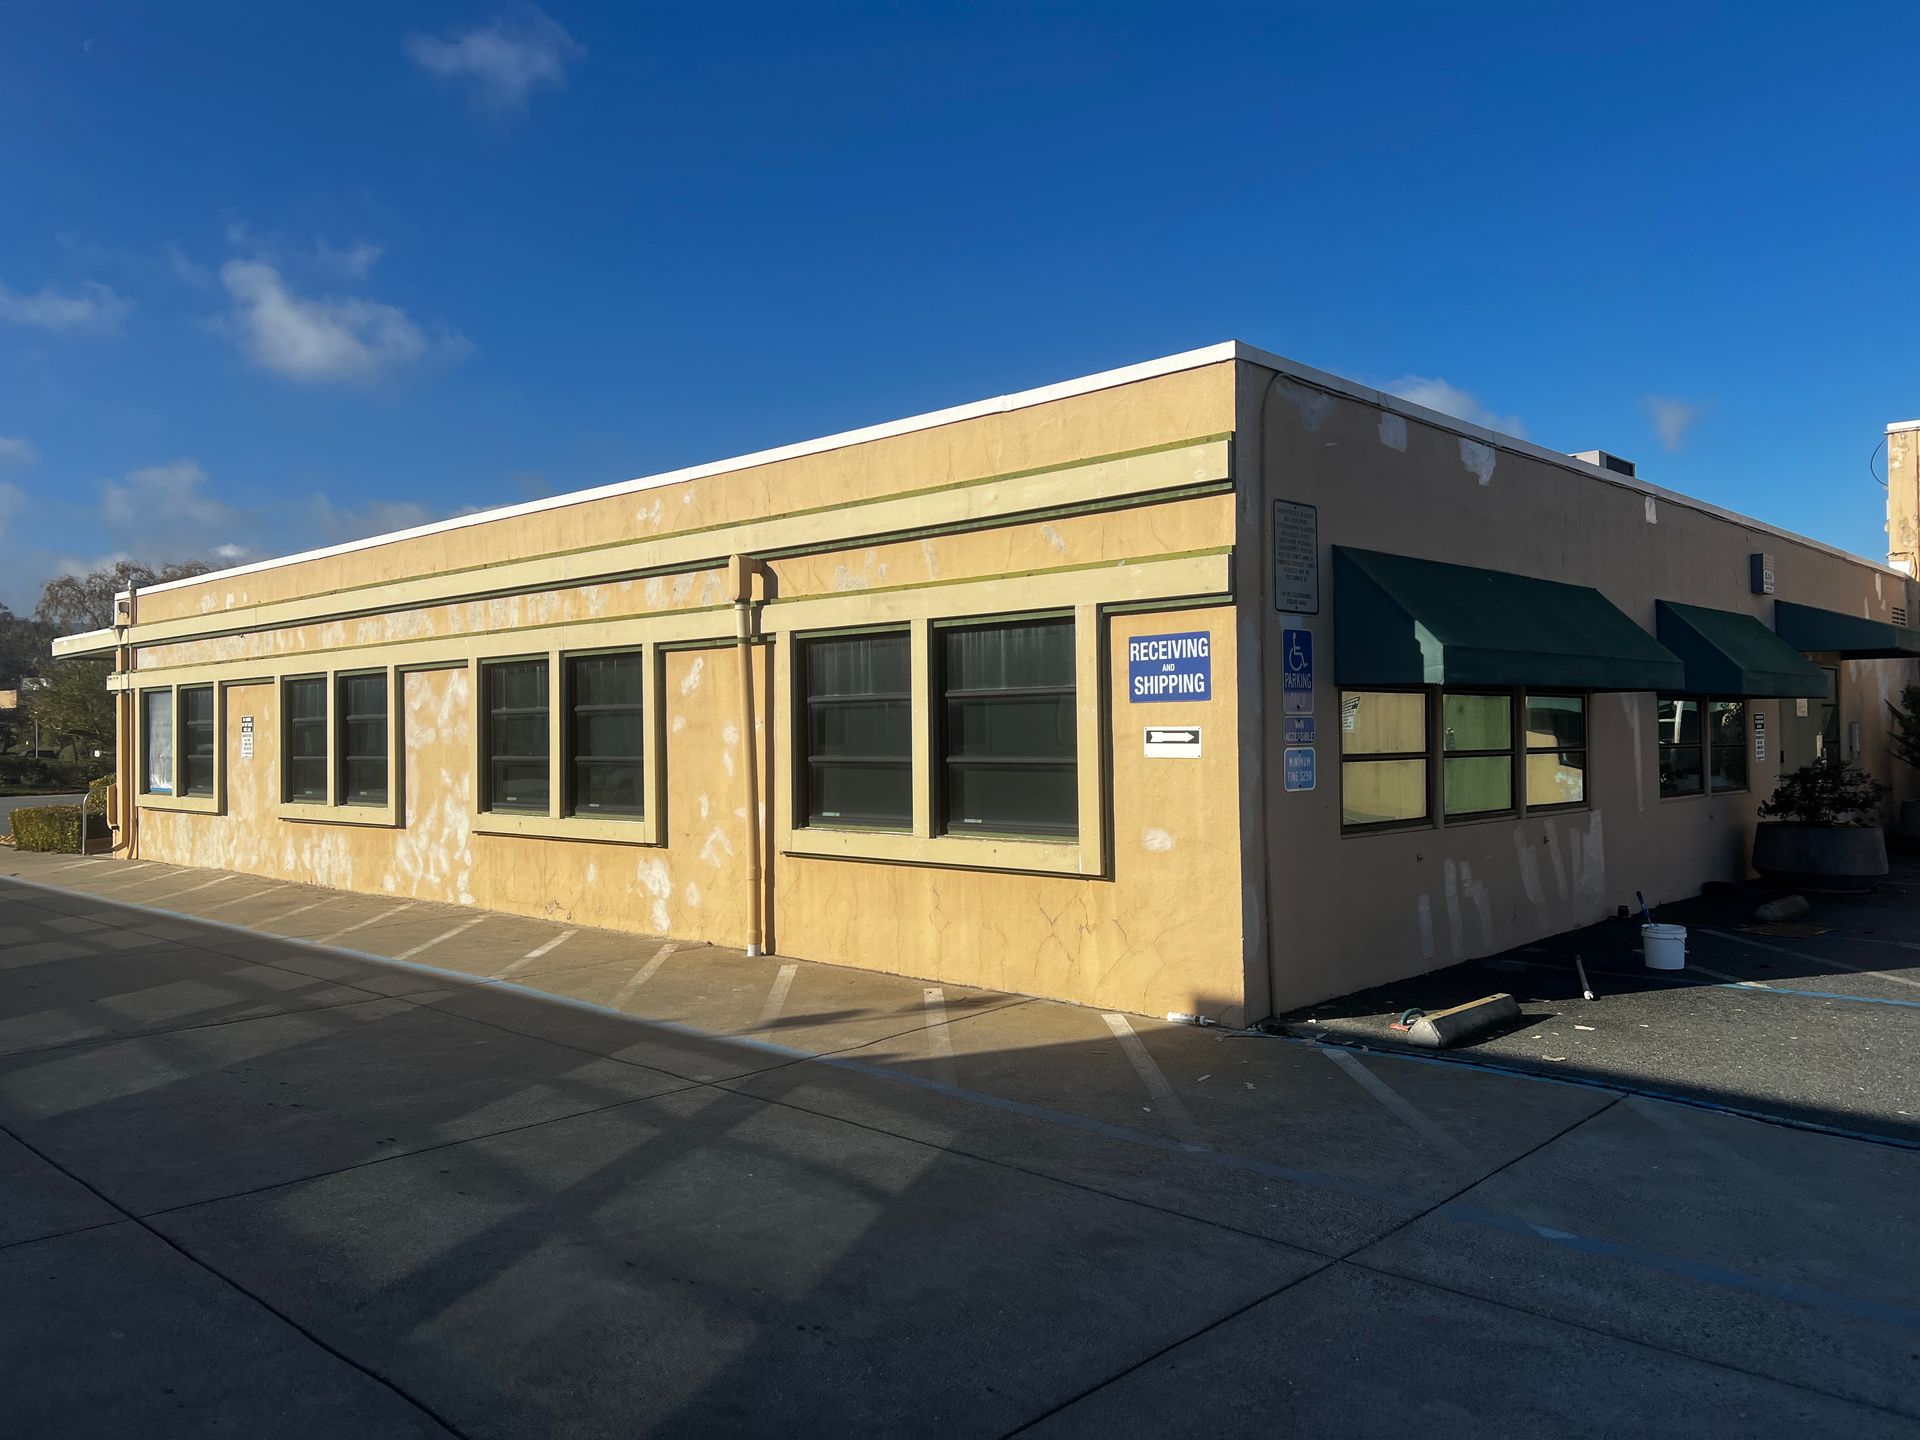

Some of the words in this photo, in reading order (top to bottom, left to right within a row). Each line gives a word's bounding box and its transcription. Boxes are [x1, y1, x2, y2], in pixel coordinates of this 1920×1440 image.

[1130, 637, 1209, 662] RECEIVING
[1162, 663, 1175, 672] AND
[1134, 673, 1205, 695] SHIPPING
[1285, 672, 1312, 689] PARKING
[1294, 720, 1305, 729] VAN
[1285, 731, 1314, 742] ACCESSIBLE
[1288, 757, 1310, 768] MINIMUM
[1288, 771, 1298, 782] FINE
